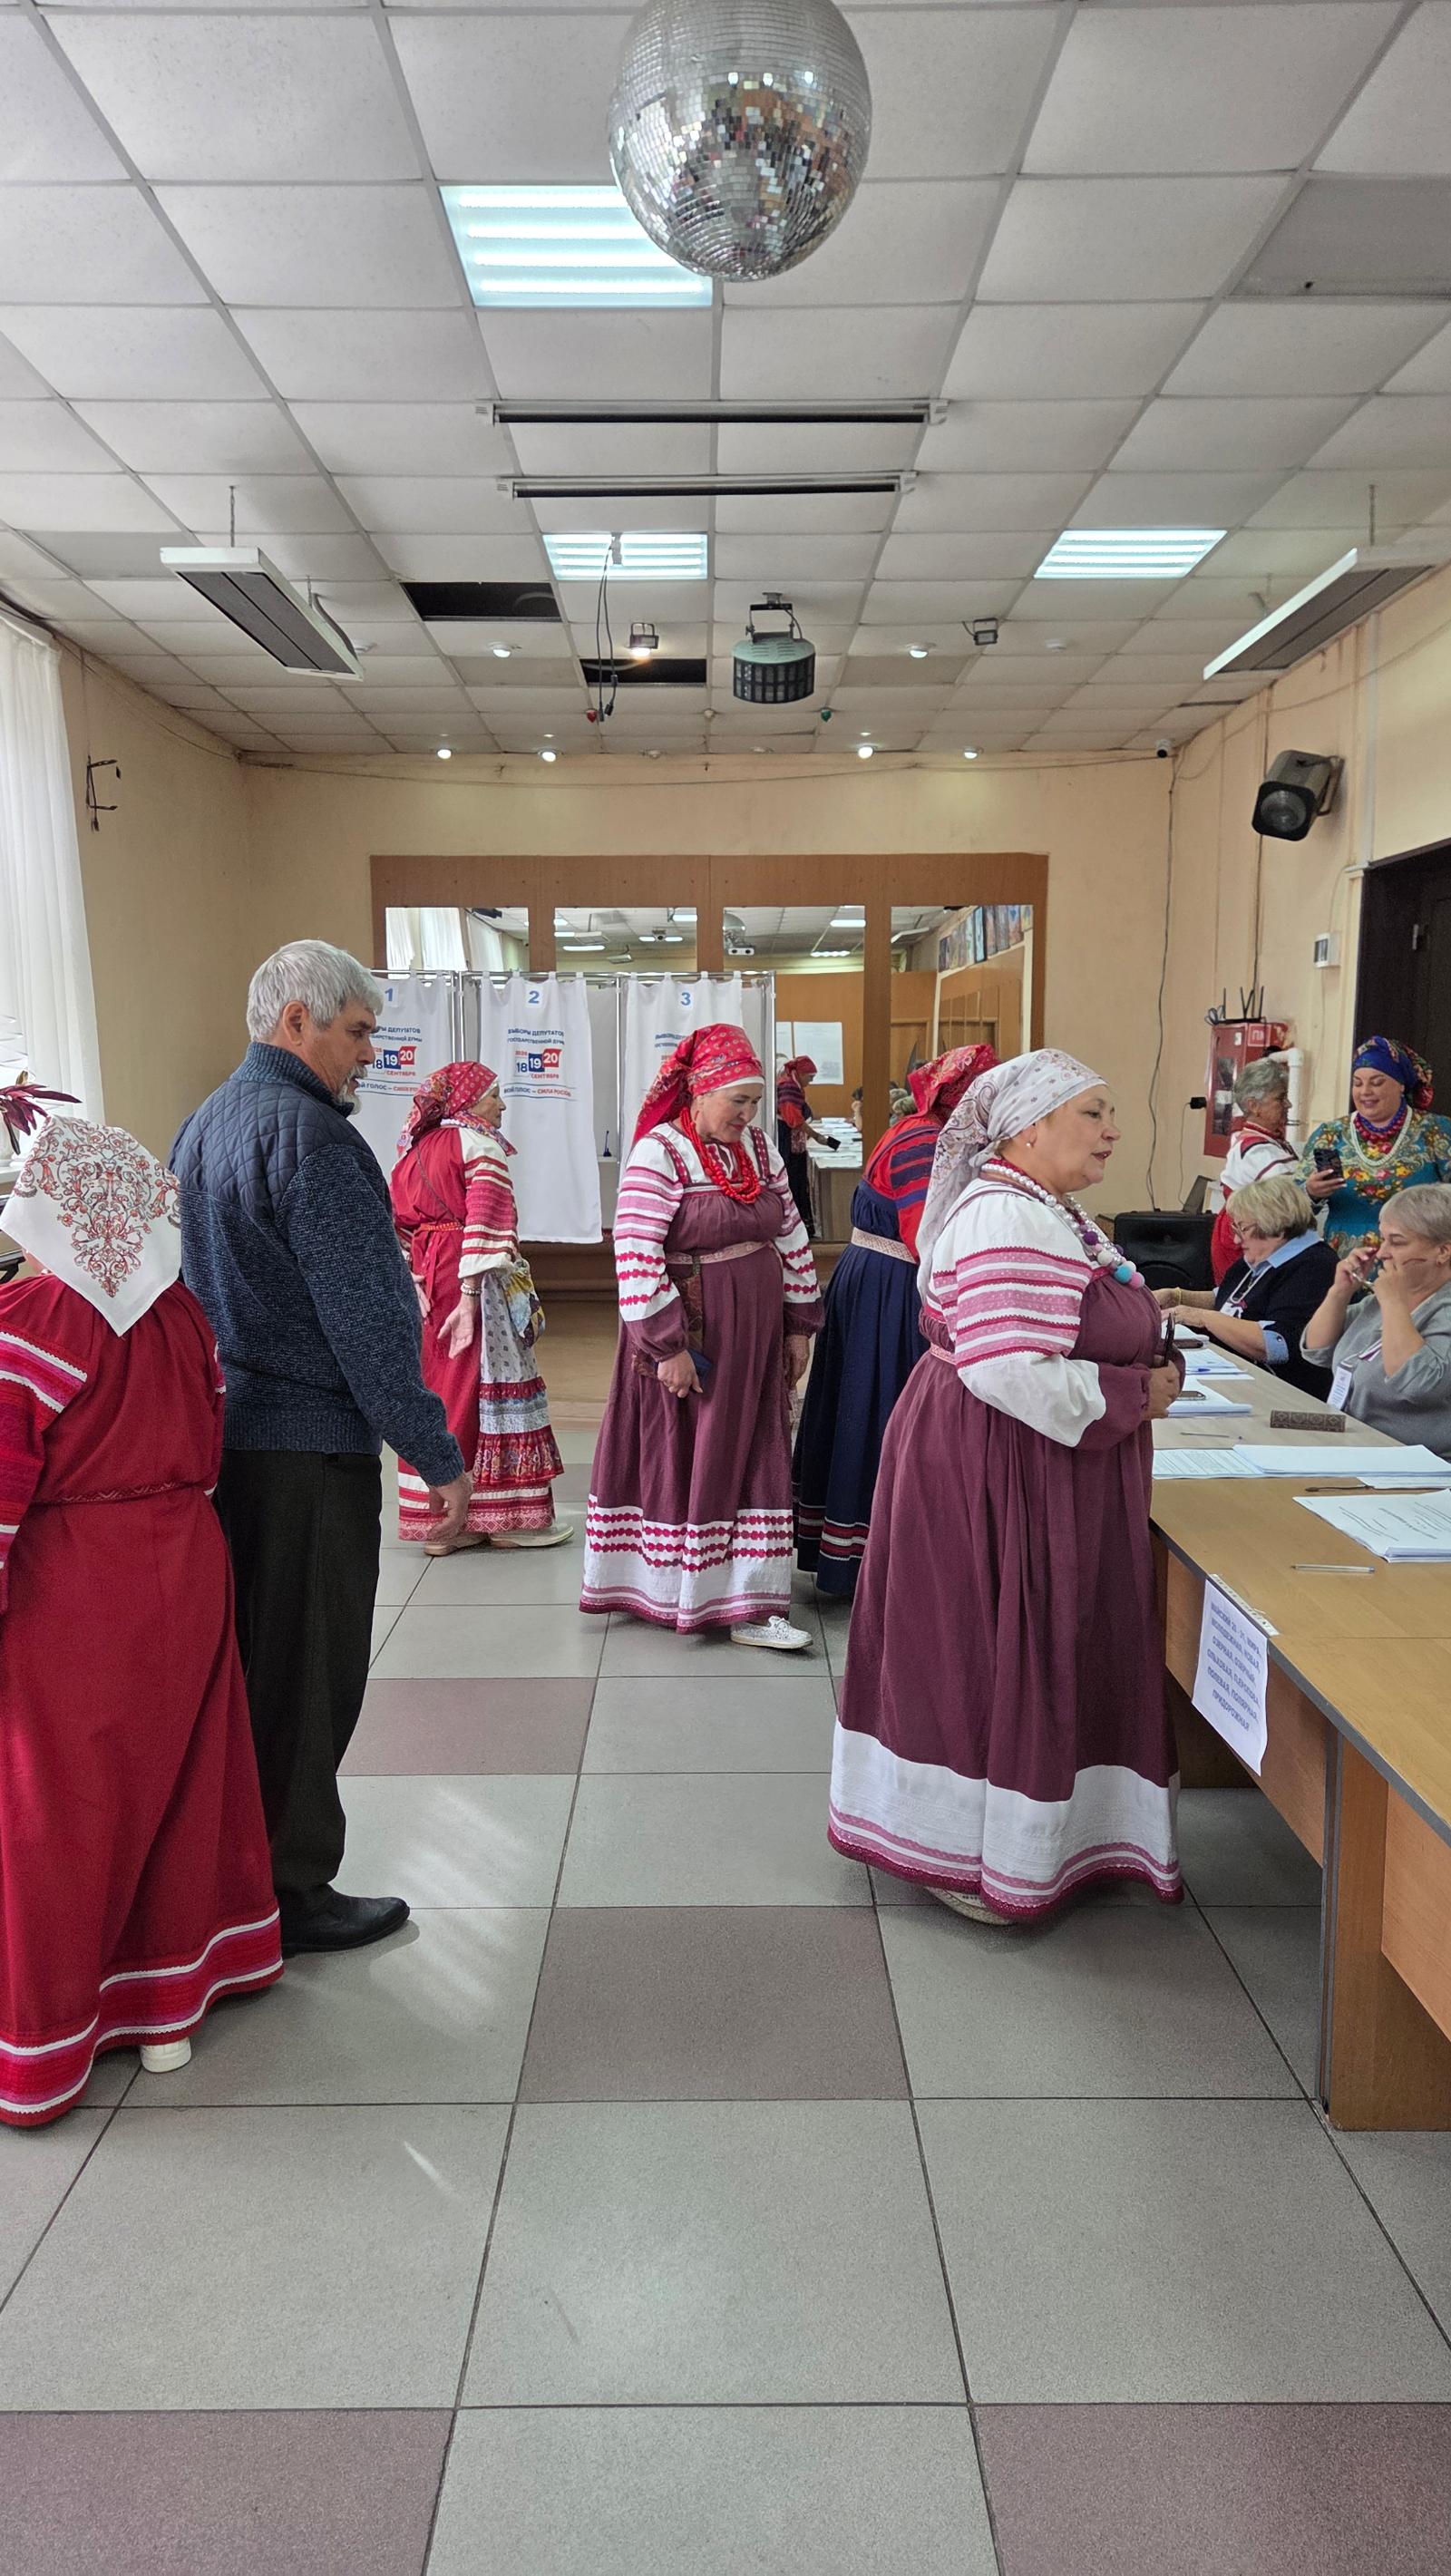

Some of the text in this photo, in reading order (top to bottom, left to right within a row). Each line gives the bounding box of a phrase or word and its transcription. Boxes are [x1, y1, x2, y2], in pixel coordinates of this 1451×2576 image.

[385, 987, 394, 1002] 1
[528, 990, 540, 1004] 2
[680, 992, 691, 1006] 3
[385, 1054, 398, 1066] 19
[400, 1050, 414, 1061] 20
[516, 1053, 559, 1074] 18 19 20
[1212, 1689, 1250, 1732] ПРИДОРОЖНАЯ
